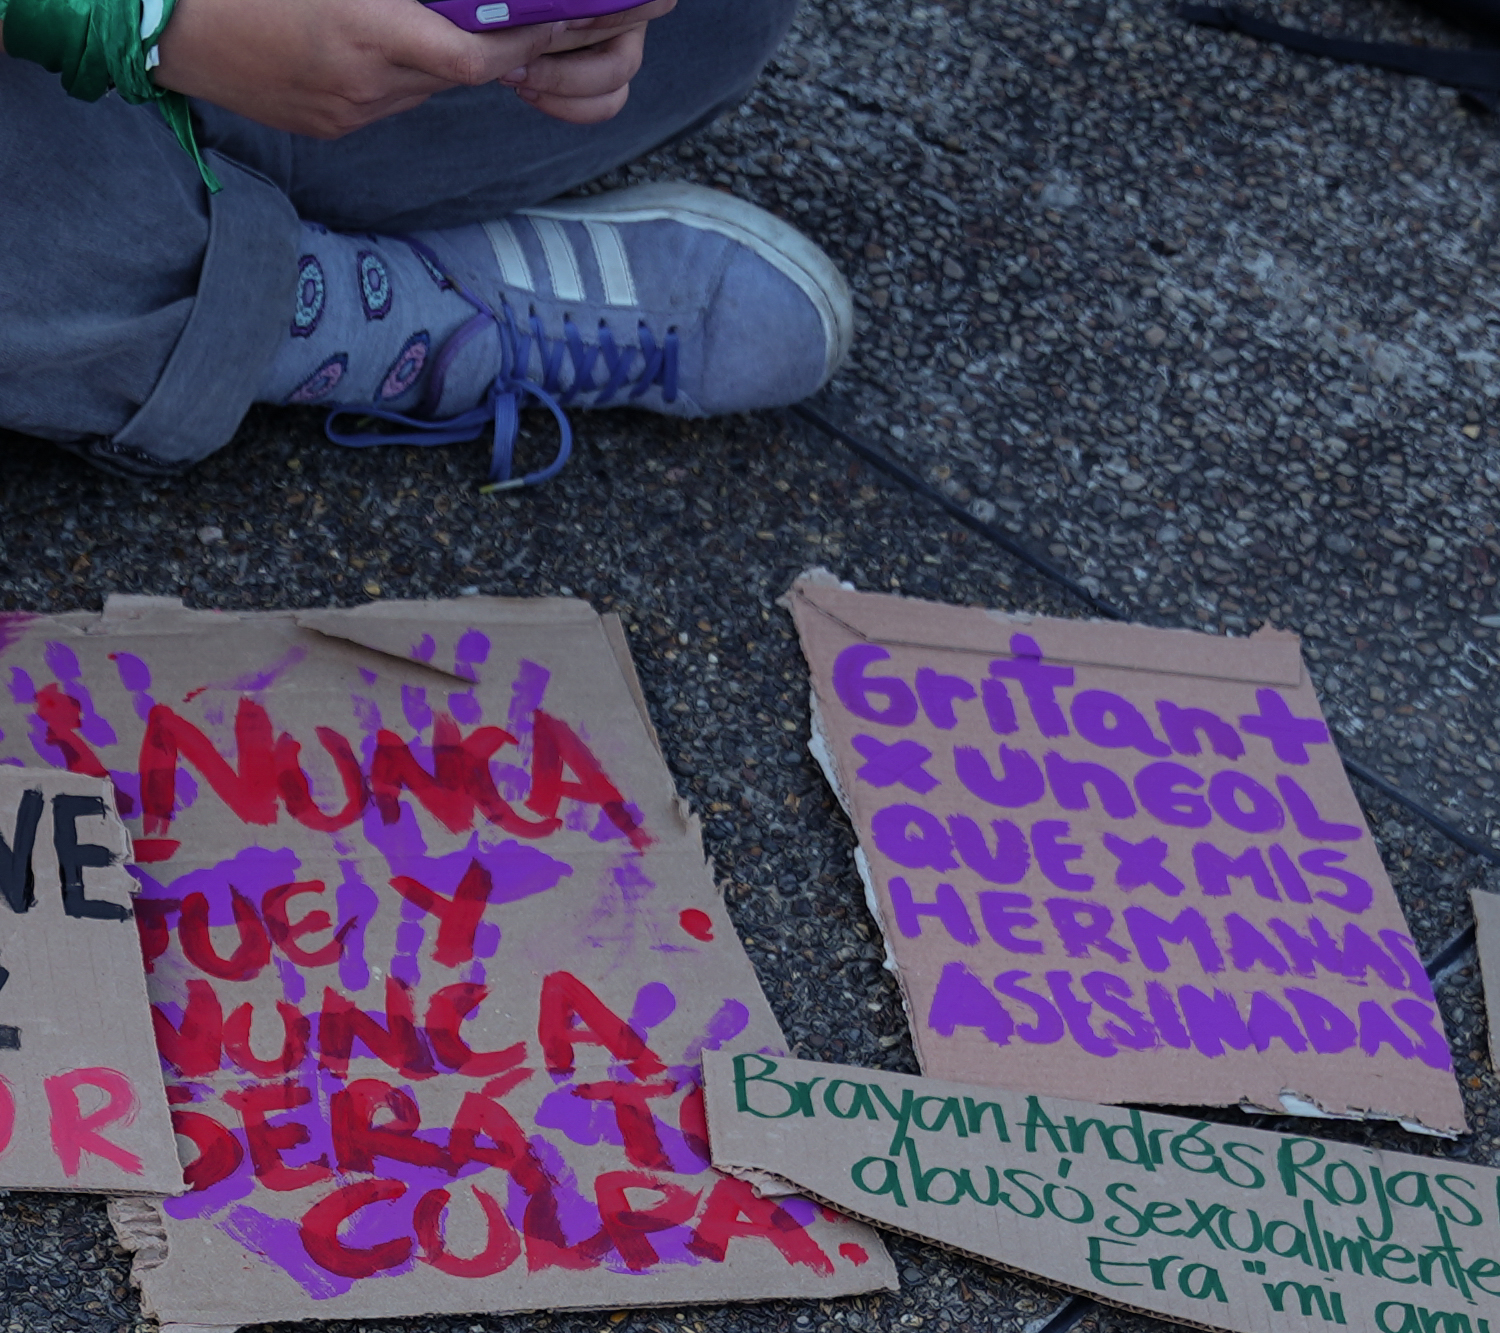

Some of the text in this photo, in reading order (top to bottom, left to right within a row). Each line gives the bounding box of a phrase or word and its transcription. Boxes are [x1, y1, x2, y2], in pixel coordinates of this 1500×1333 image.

[390, 858, 492, 965] Y
[871, 802, 1096, 892] QUE
[1192, 840, 1375, 915] MIS
[888, 876, 1437, 1002] HERMANAS
[928, 961, 1454, 1073] ASESINADAS
[733, 1053, 1010, 1158] Brayan
[1013, 1095, 1265, 1189] Andrés
[1277, 1136, 1479, 1242] Rojas
[851, 1136, 1095, 1226] abusó
[1086, 1236, 1227, 1306] Era
